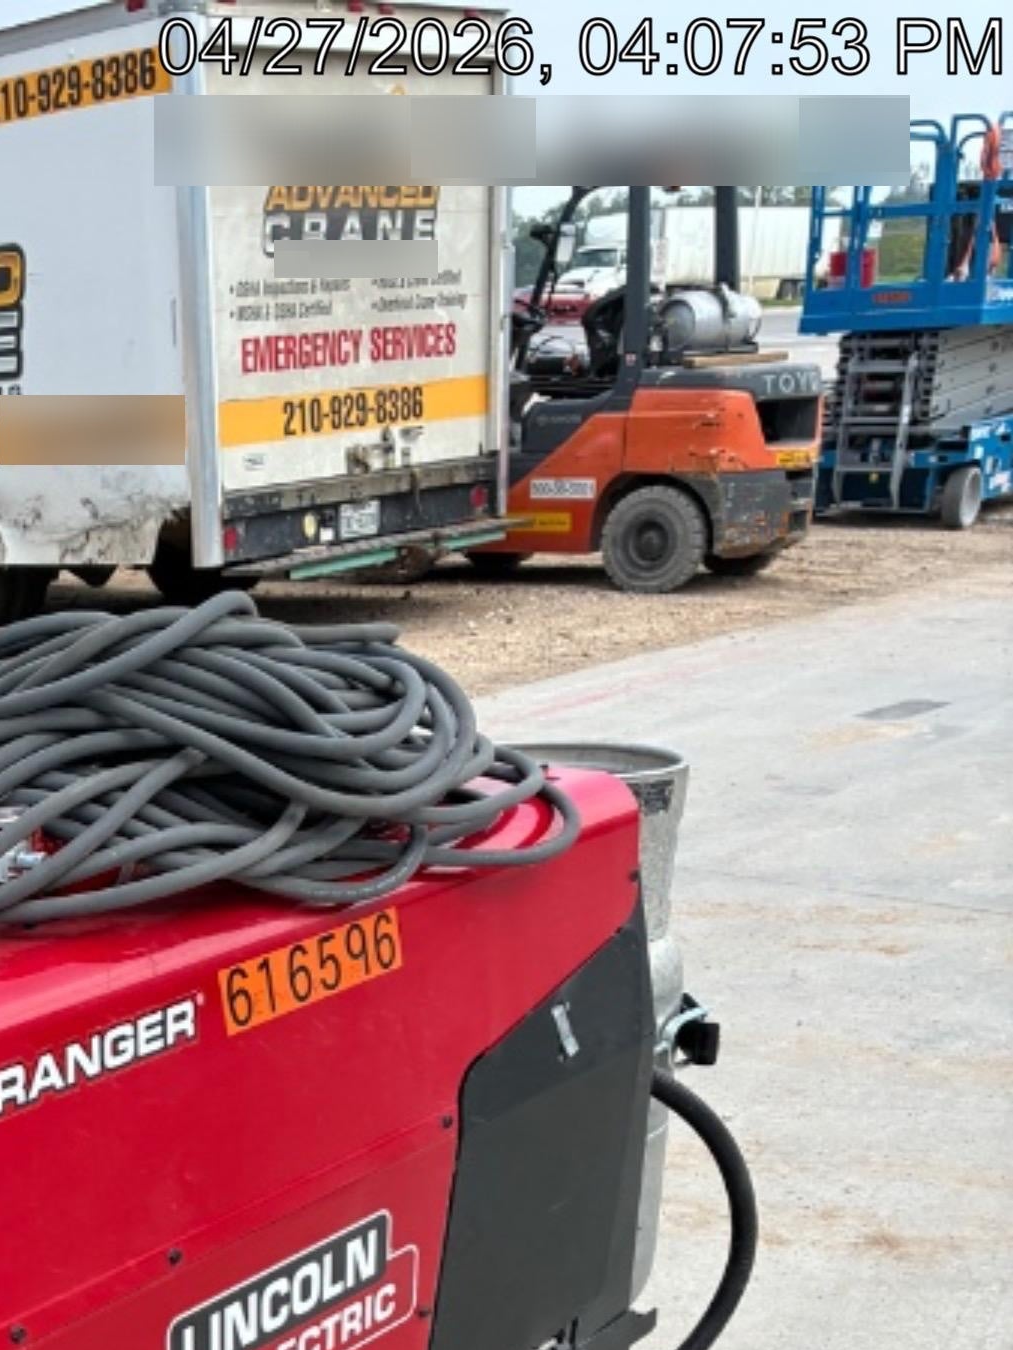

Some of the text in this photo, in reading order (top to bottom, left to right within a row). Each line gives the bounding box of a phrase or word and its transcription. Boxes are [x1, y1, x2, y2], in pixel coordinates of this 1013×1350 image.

[242, 323, 456, 374] EMERGENCY SERVICES
[283, 386, 423, 435] 210-929-8386
[225, 913, 398, 1027] 616596
